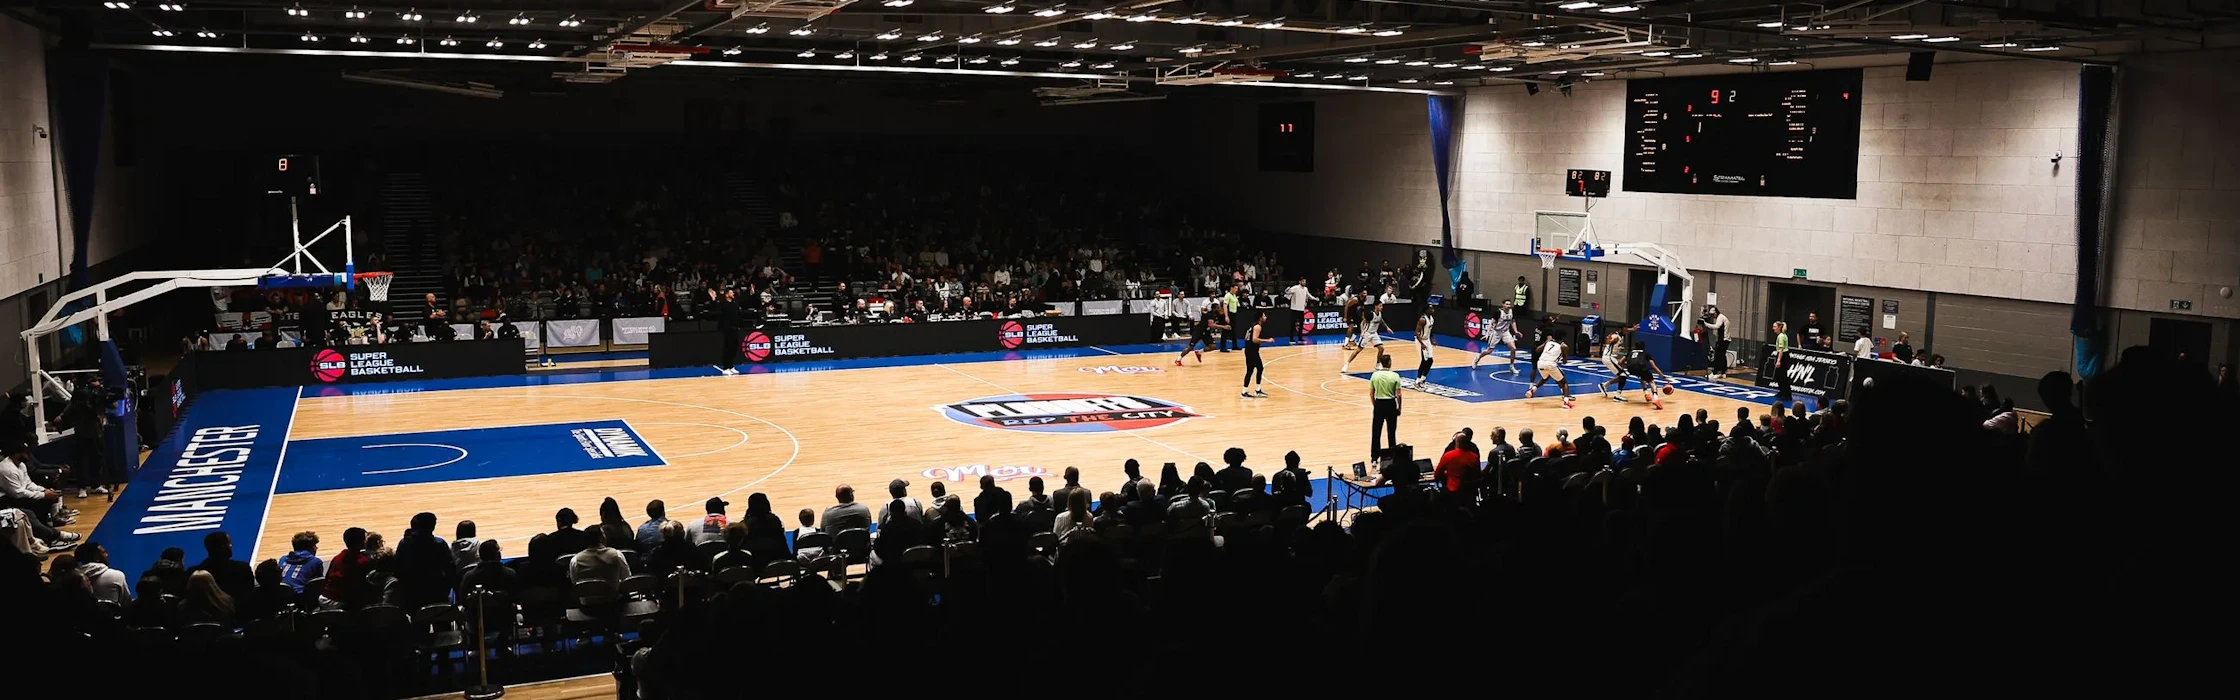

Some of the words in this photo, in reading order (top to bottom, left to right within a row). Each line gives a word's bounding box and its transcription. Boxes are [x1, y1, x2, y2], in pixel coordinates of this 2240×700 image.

[1711, 90, 1719, 104] 9
[1729, 90, 1736, 102] 2
[1280, 124, 1293, 132] 11
[278, 158, 288, 171] 8
[331, 310, 383, 320] EAGLES
[774, 334, 805, 343] SUPER
[1026, 335, 1079, 344] BASKETBALL
[774, 341, 811, 349] LEAGUE
[1548, 343, 1555, 351] 7
[774, 347, 835, 356] BASKETBALL
[350, 352, 387, 361] SUPER
[320, 361, 346, 369] SLB
[350, 359, 394, 368] LEAGUE
[350, 365, 424, 376] BASKETBALL
[1001, 416, 1057, 426] REP
[1064, 413, 1114, 423] THE
[1121, 410, 1174, 419] CITY
[132, 424, 262, 535] MANCHESTER
